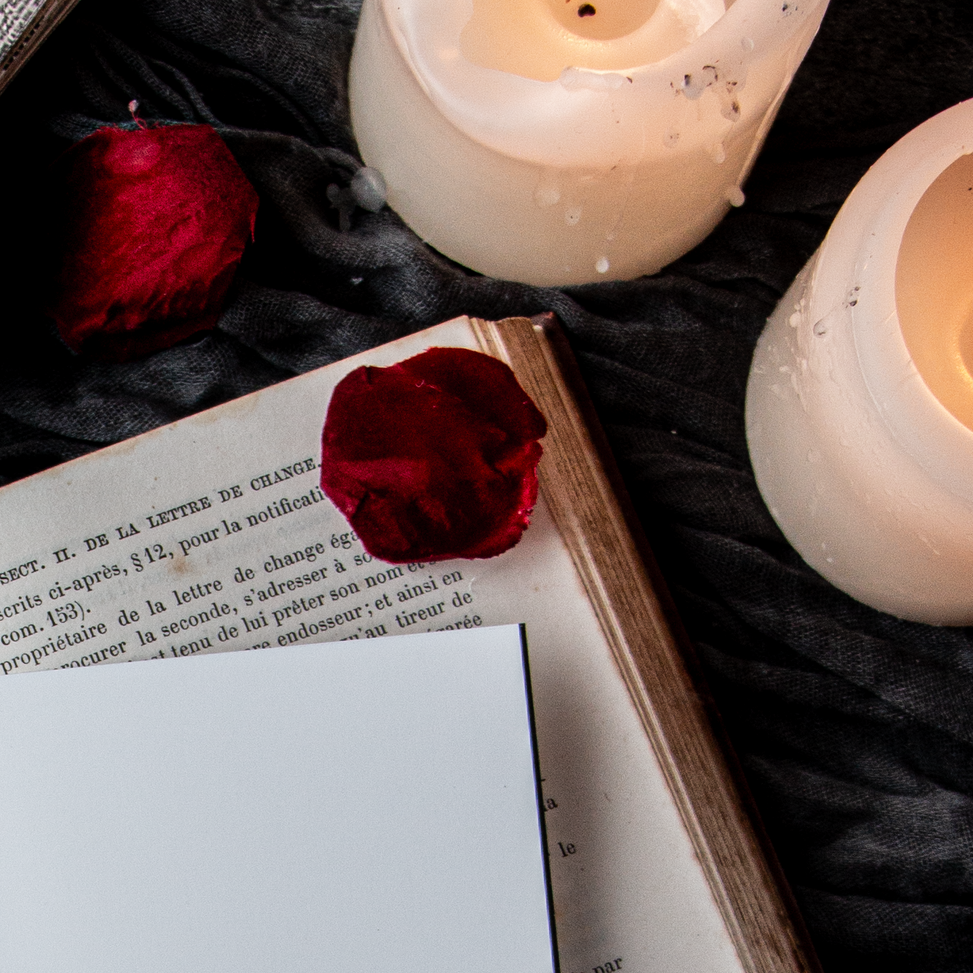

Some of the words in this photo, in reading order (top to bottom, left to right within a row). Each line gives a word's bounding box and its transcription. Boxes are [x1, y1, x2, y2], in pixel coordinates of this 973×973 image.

[49, 564, 128, 600] ci-après,
[178, 528, 219, 557] pour
[221, 520, 243, 535] la
[245, 486, 325, 527] notificati
[52, 548, 76, 564] II.
[83, 533, 109, 552] DE
[115, 523, 141, 540] LA
[146, 496, 212, 529] LETTRE
[217, 485, 243, 503] DE
[250, 458, 321, 491] CHANGE.
[0, 623, 107, 675] propriétaire
[118, 609, 140, 626] de
[145, 600, 167, 616] la
[172, 580, 223, 606] lettre
[234, 567, 255, 583] de
[264, 543, 325, 573] change
[330, 531, 357, 549] éga
[1, 624, 44, 646] com.
[47, 601, 91, 627] 153).
[54, 640, 127, 671] rocurer
[135, 630, 157, 646] la
[161, 602, 238, 637] seconde,
[333, 559, 347, 573] à
[354, 553, 372, 566] so
[171, 637, 213, 658] tenu
[217, 625, 239, 642] de
[241, 611, 269, 633] lui
[271, 594, 325, 627] prêter
[329, 583, 360, 601] son
[364, 567, 404, 588] nom
[375, 593, 393, 610] et
[397, 575, 438, 602] ainsi
[442, 571, 463, 585] en
[395, 602, 445, 628] tireur
[452, 591, 472, 608] de
[558, 841, 576, 857] le
